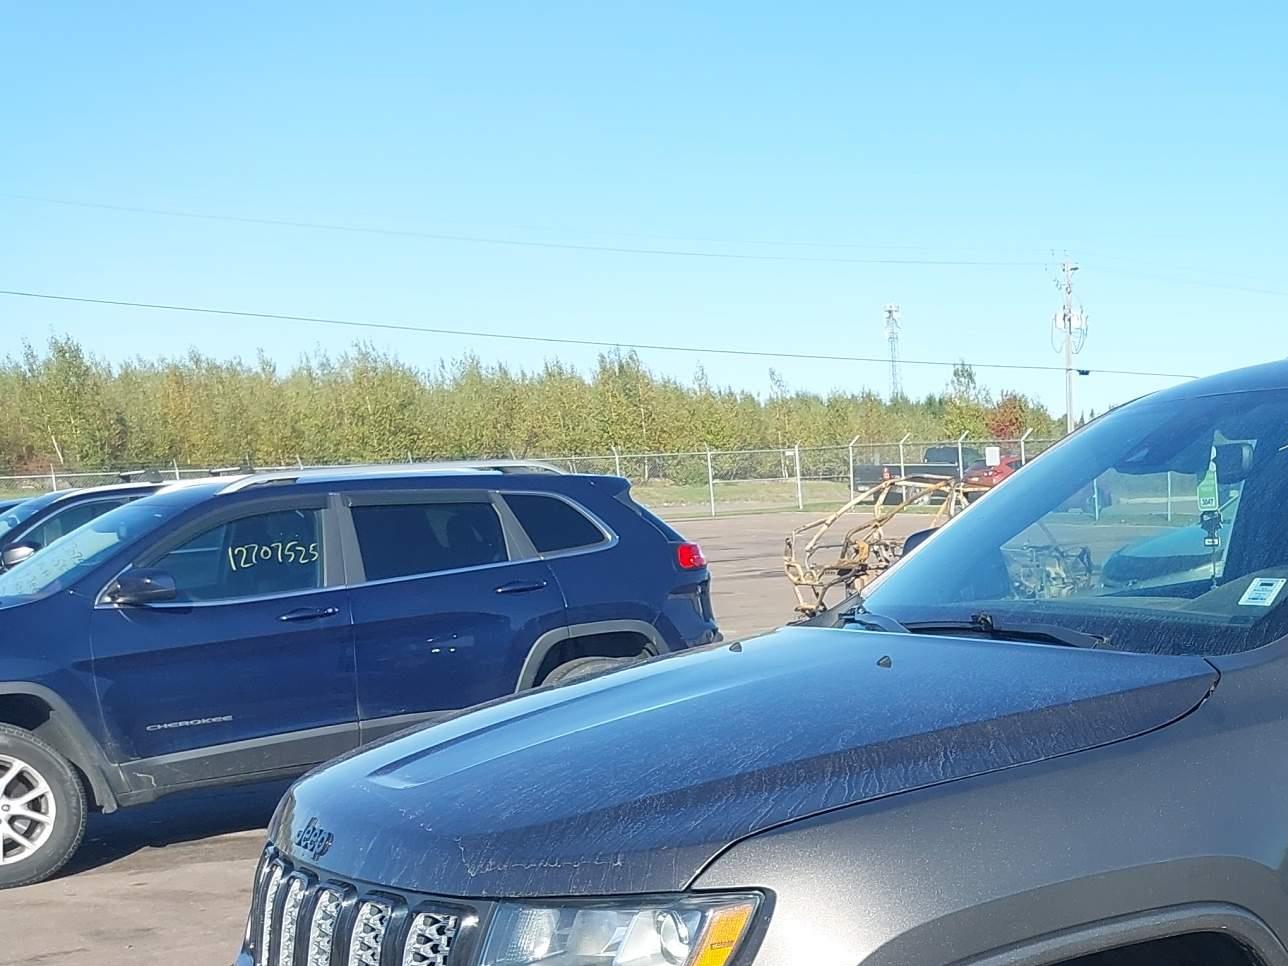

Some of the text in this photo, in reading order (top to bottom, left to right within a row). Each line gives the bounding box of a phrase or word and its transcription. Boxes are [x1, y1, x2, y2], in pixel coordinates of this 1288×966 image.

[228, 541, 319, 571] 12707525
[146, 715, 233, 731] CHEROKEE
[295, 816, 335, 862] Jeep
